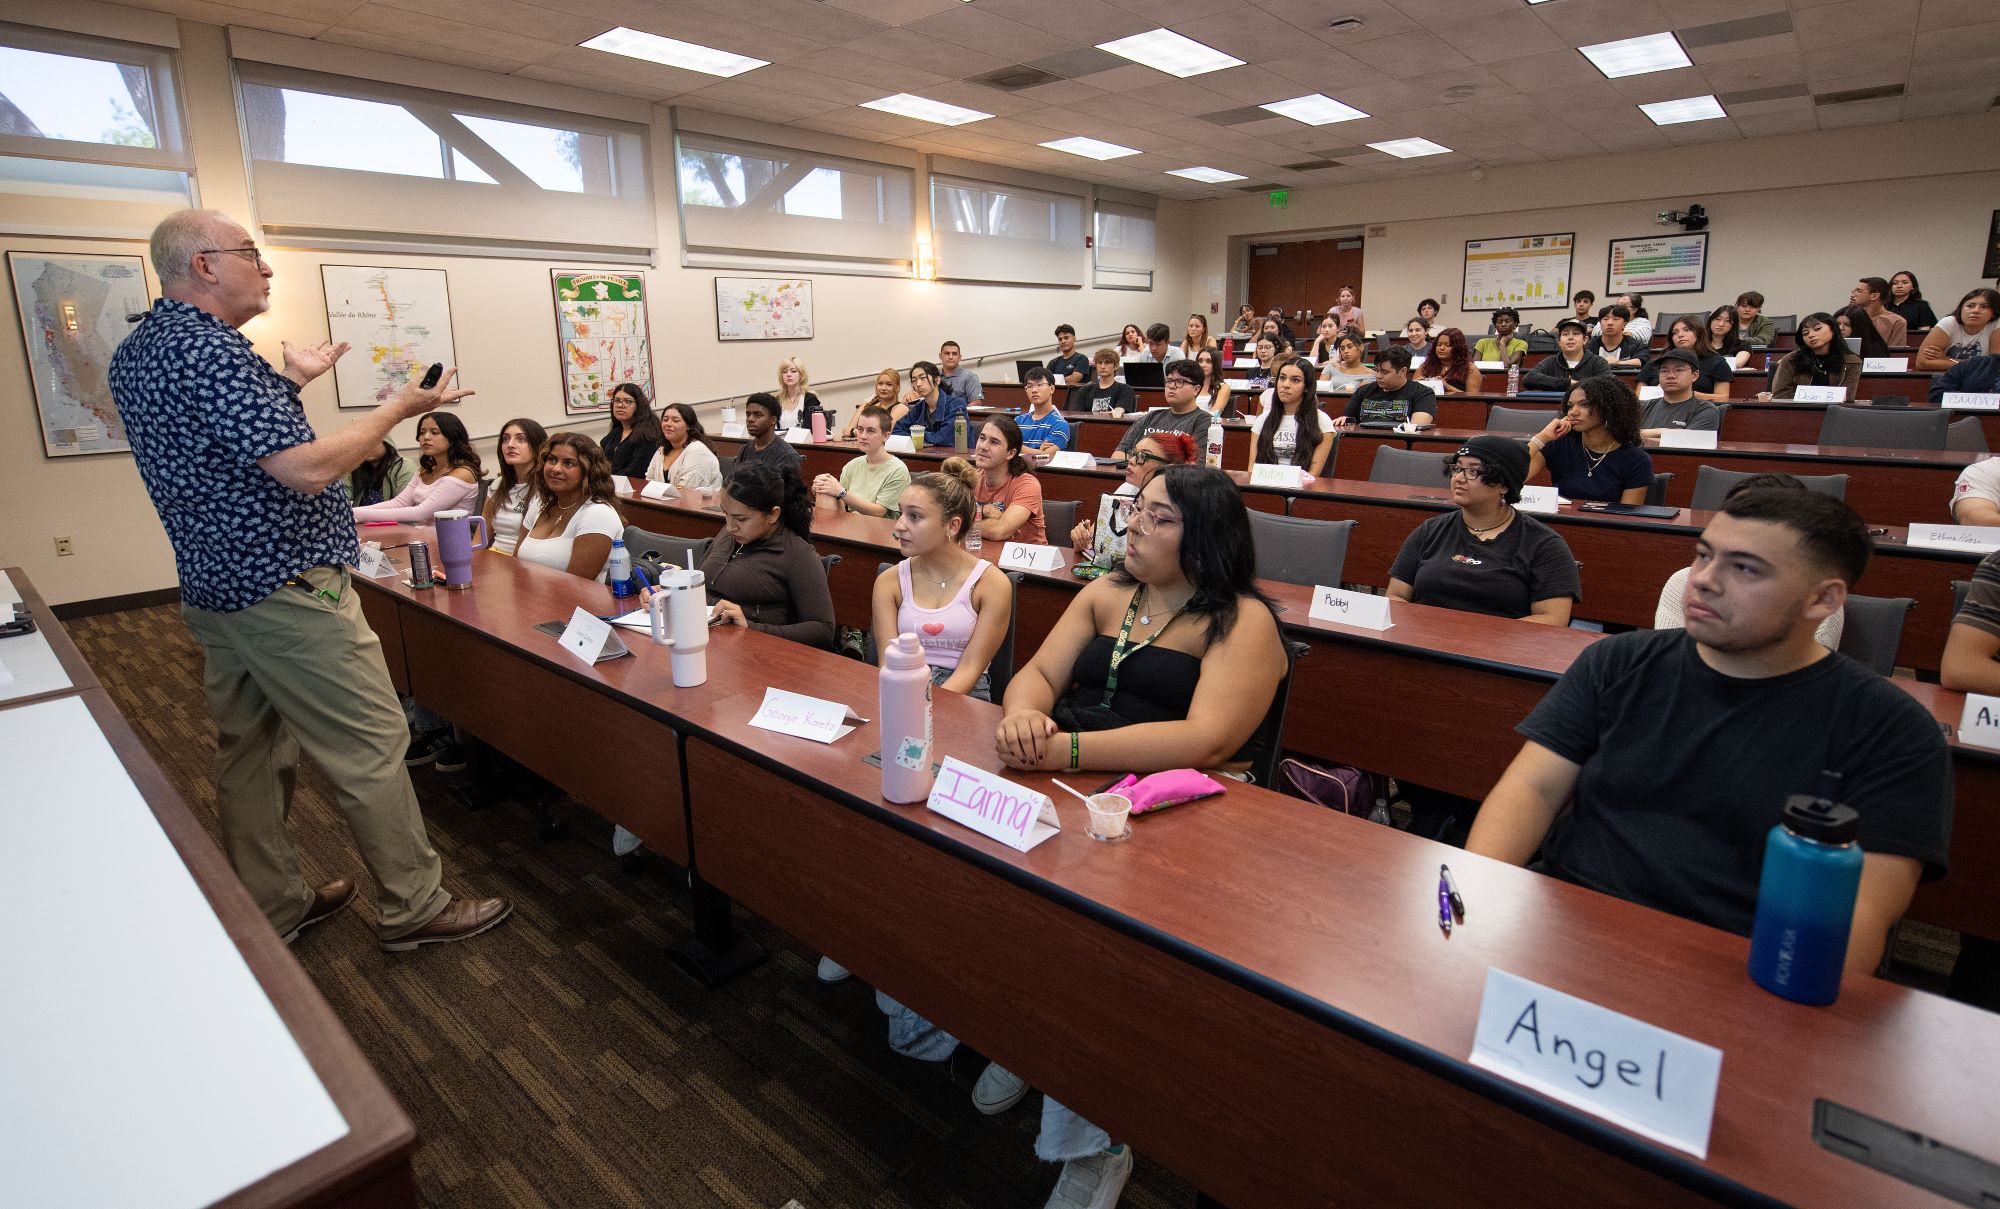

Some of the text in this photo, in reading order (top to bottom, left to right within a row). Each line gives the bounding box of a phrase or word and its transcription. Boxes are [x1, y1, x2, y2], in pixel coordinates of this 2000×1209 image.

[1012, 547, 1037, 567] Oly
[1325, 593, 1349, 613] Robby
[762, 697, 798, 726] George
[938, 767, 1032, 837] Ianna
[1504, 998, 1666, 1101] Angel
